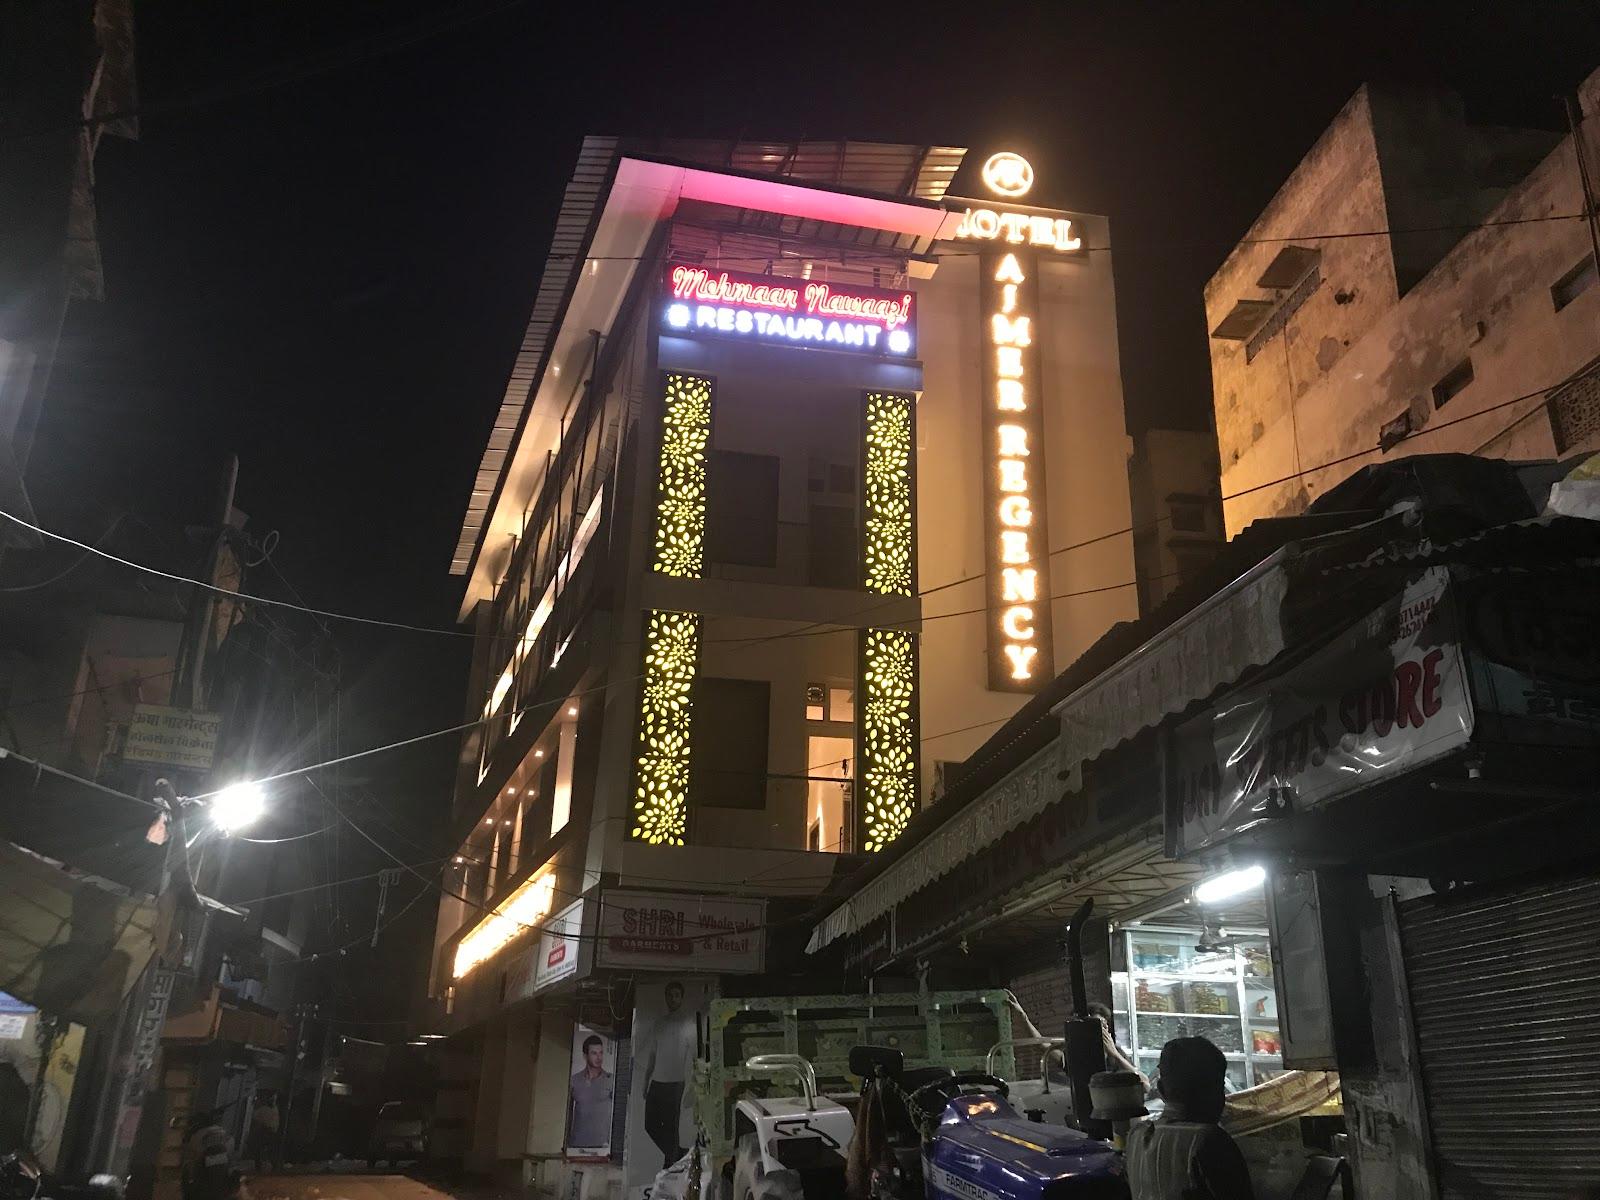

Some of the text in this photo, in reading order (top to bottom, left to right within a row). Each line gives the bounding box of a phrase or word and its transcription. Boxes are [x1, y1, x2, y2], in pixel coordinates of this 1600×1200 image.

[672, 265, 912, 330] Mehmaan Nawaazi
[695, 304, 883, 348] RESTAURANT
[992, 253, 1031, 412] AJMER
[997, 424, 1038, 680] REGENCY
[1340, 648, 1444, 737] STORE
[622, 907, 684, 936] SHRI
[622, 938, 681, 952] GARMENTS
[716, 938, 750, 953] Retail
